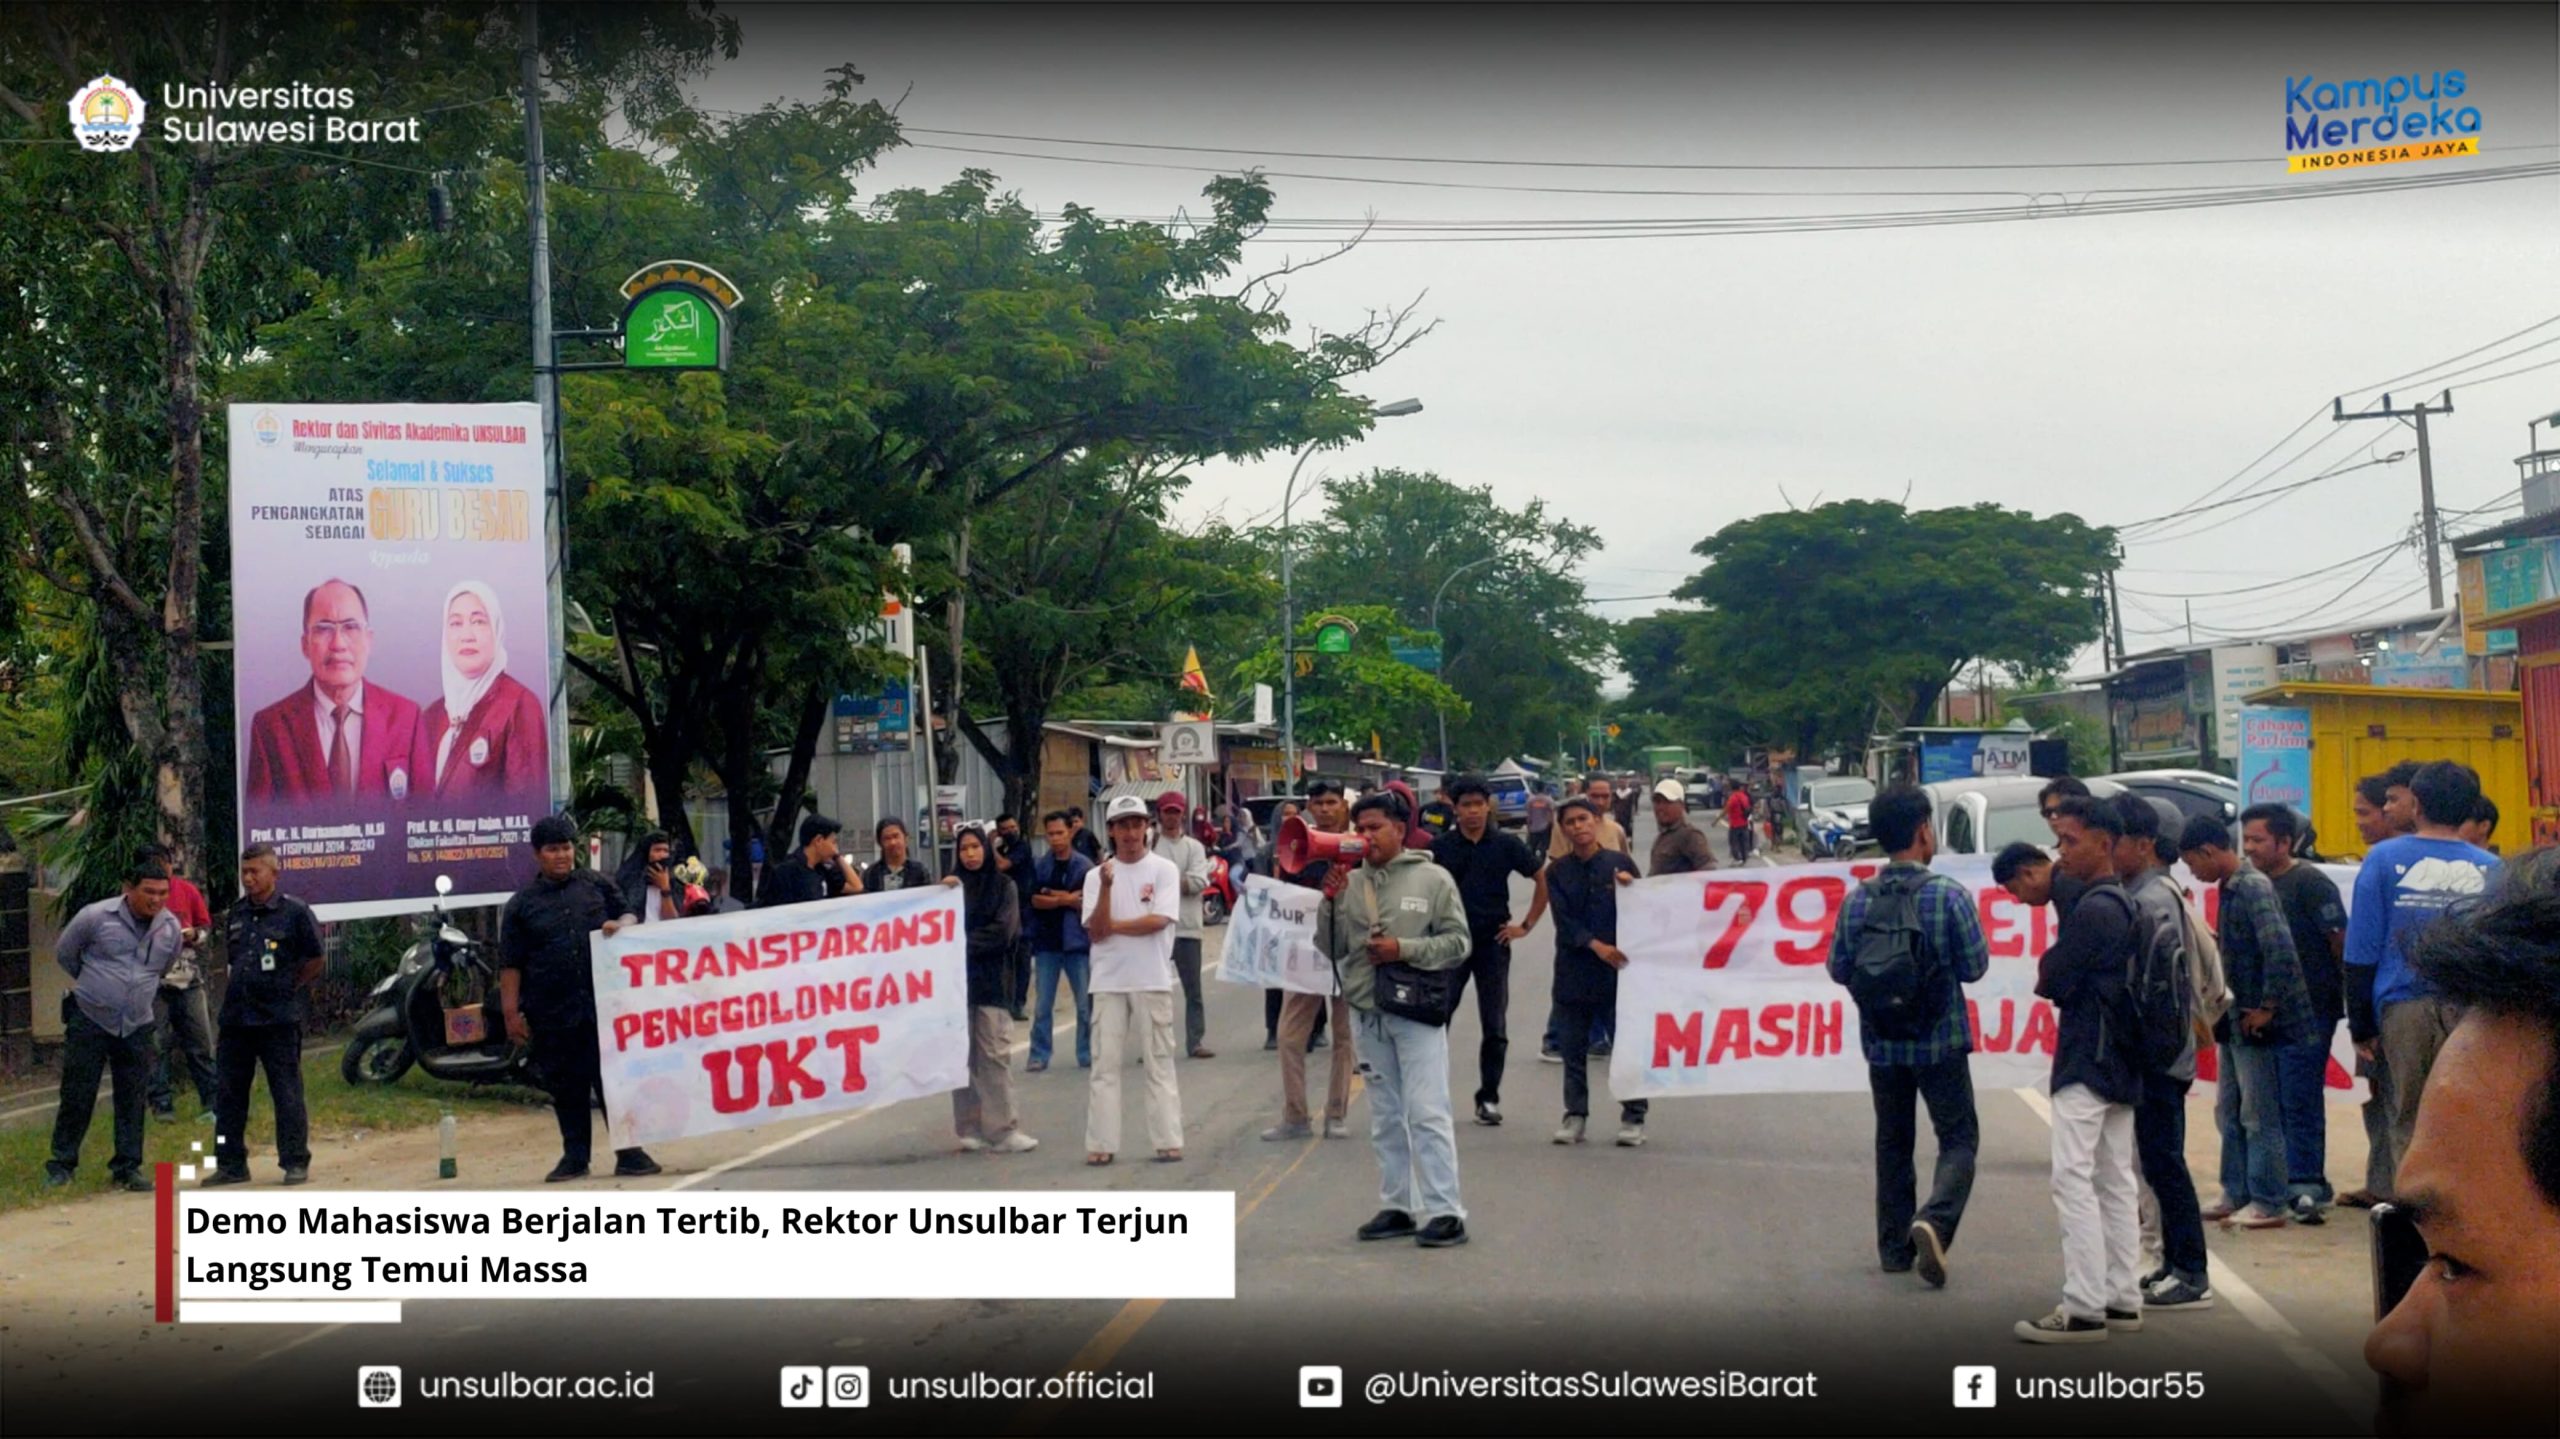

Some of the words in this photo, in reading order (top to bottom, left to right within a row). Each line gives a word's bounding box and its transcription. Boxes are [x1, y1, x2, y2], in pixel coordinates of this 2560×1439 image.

[293, 419, 332, 438] Rektor
[336, 420, 359, 439] dan
[362, 420, 402, 440] Sivitas
[405, 422, 469, 442] Akademika
[473, 424, 526, 444] UNSULBAR
[367, 458, 426, 482] Selamat
[443, 461, 495, 483] Sukses
[328, 488, 364, 502] ATAS
[251, 505, 364, 521] PENGANGKATAN
[368, 486, 441, 541] GURU
[447, 487, 531, 543] BESAR
[304, 524, 365, 539] SEBAGAI
[1986, 749, 2028, 765] ATM
[620, 909, 956, 988] TRANSPARANSI
[613, 970, 933, 1052] PENGGOLONGAN
[1652, 1000, 1844, 1068] MASIH
[701, 1024, 880, 1114] UKT
